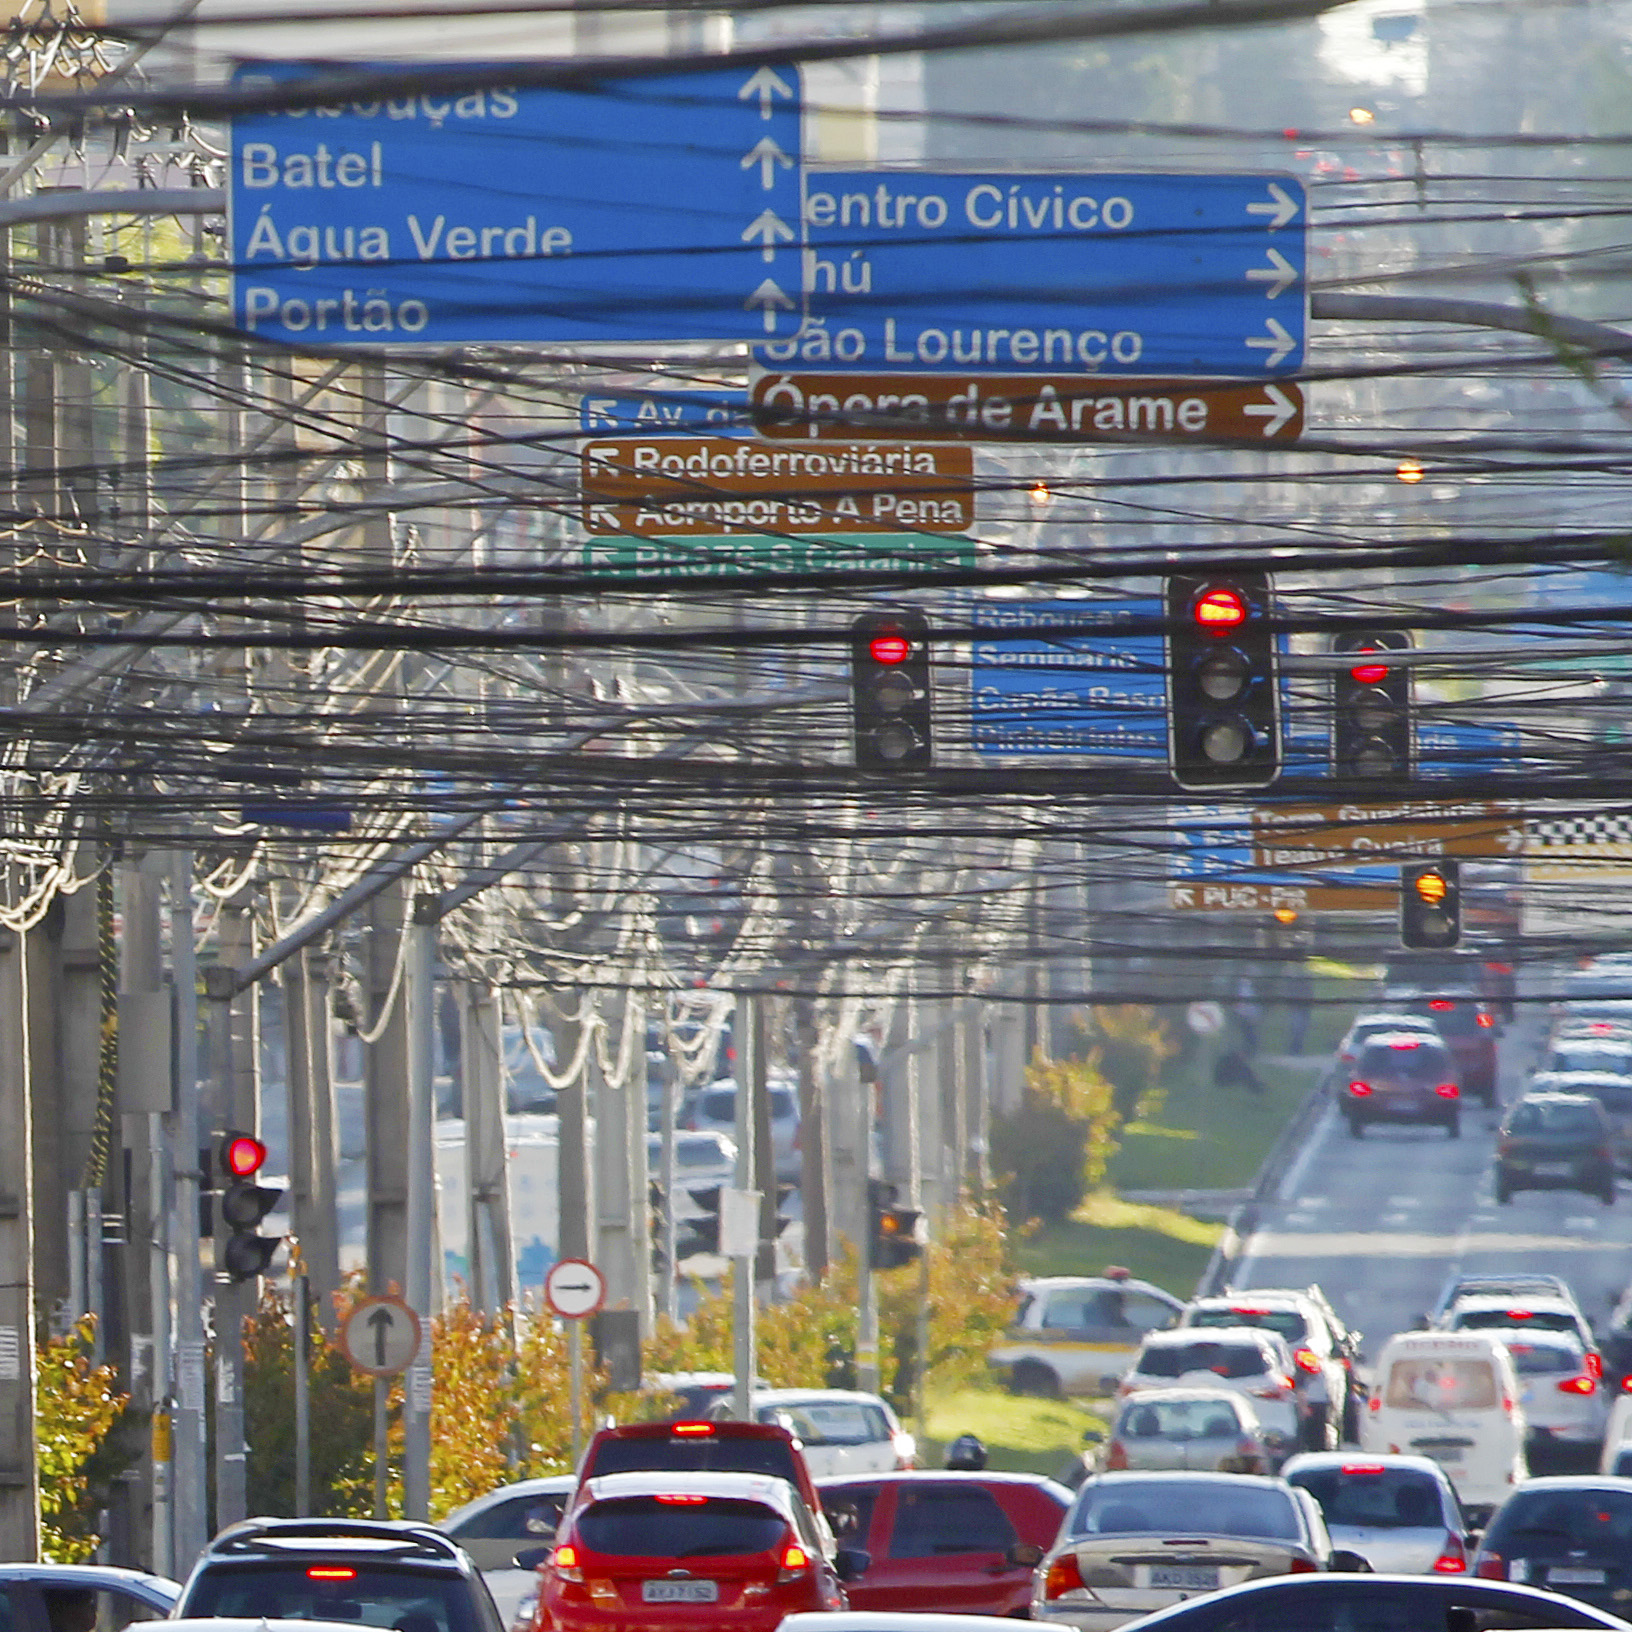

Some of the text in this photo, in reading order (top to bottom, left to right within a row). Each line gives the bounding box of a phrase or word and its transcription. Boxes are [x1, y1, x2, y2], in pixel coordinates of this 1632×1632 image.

[242, 141, 383, 189] Batel
[965, 183, 1135, 230] Cívico
[245, 203, 574, 270] Água Verde
[245, 287, 429, 332] Portão
[884, 317, 1143, 371] Lourenço
[1028, 384, 1208, 431] Arame
[634, 445, 936, 479] Rodoferroviária
